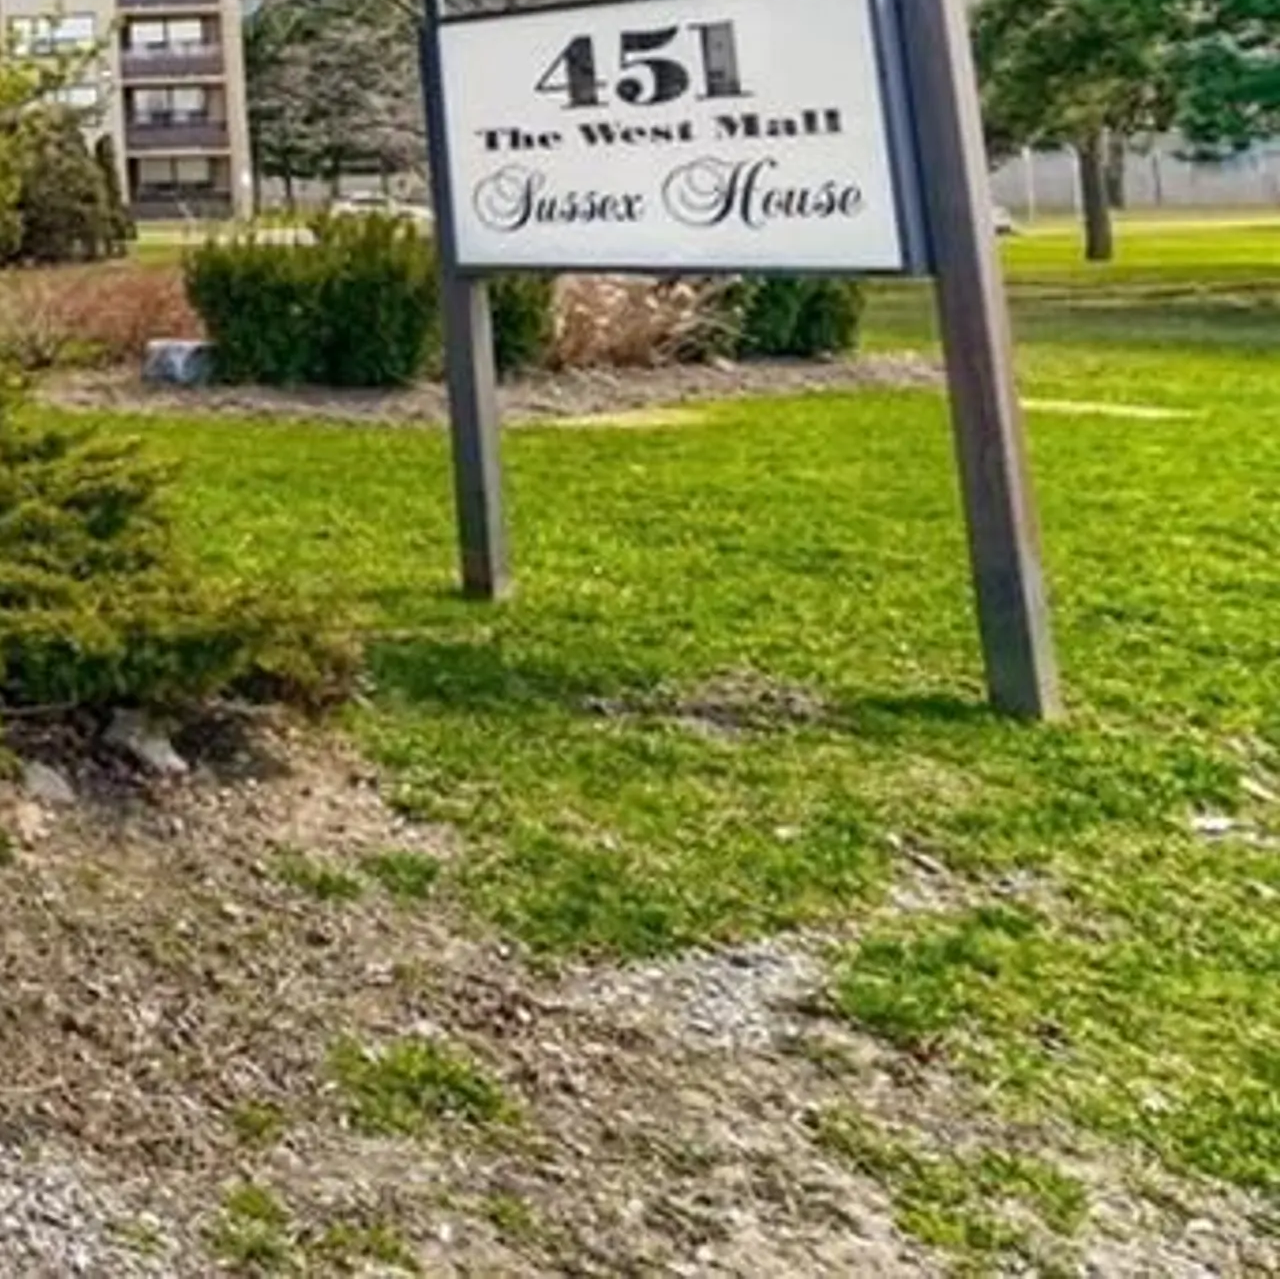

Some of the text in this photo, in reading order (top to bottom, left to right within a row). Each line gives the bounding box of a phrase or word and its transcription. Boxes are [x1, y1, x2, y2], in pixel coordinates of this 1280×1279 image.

[534, 19, 754, 109] 451
[474, 107, 842, 151] The West Mall
[473, 156, 866, 232] Sussex House
